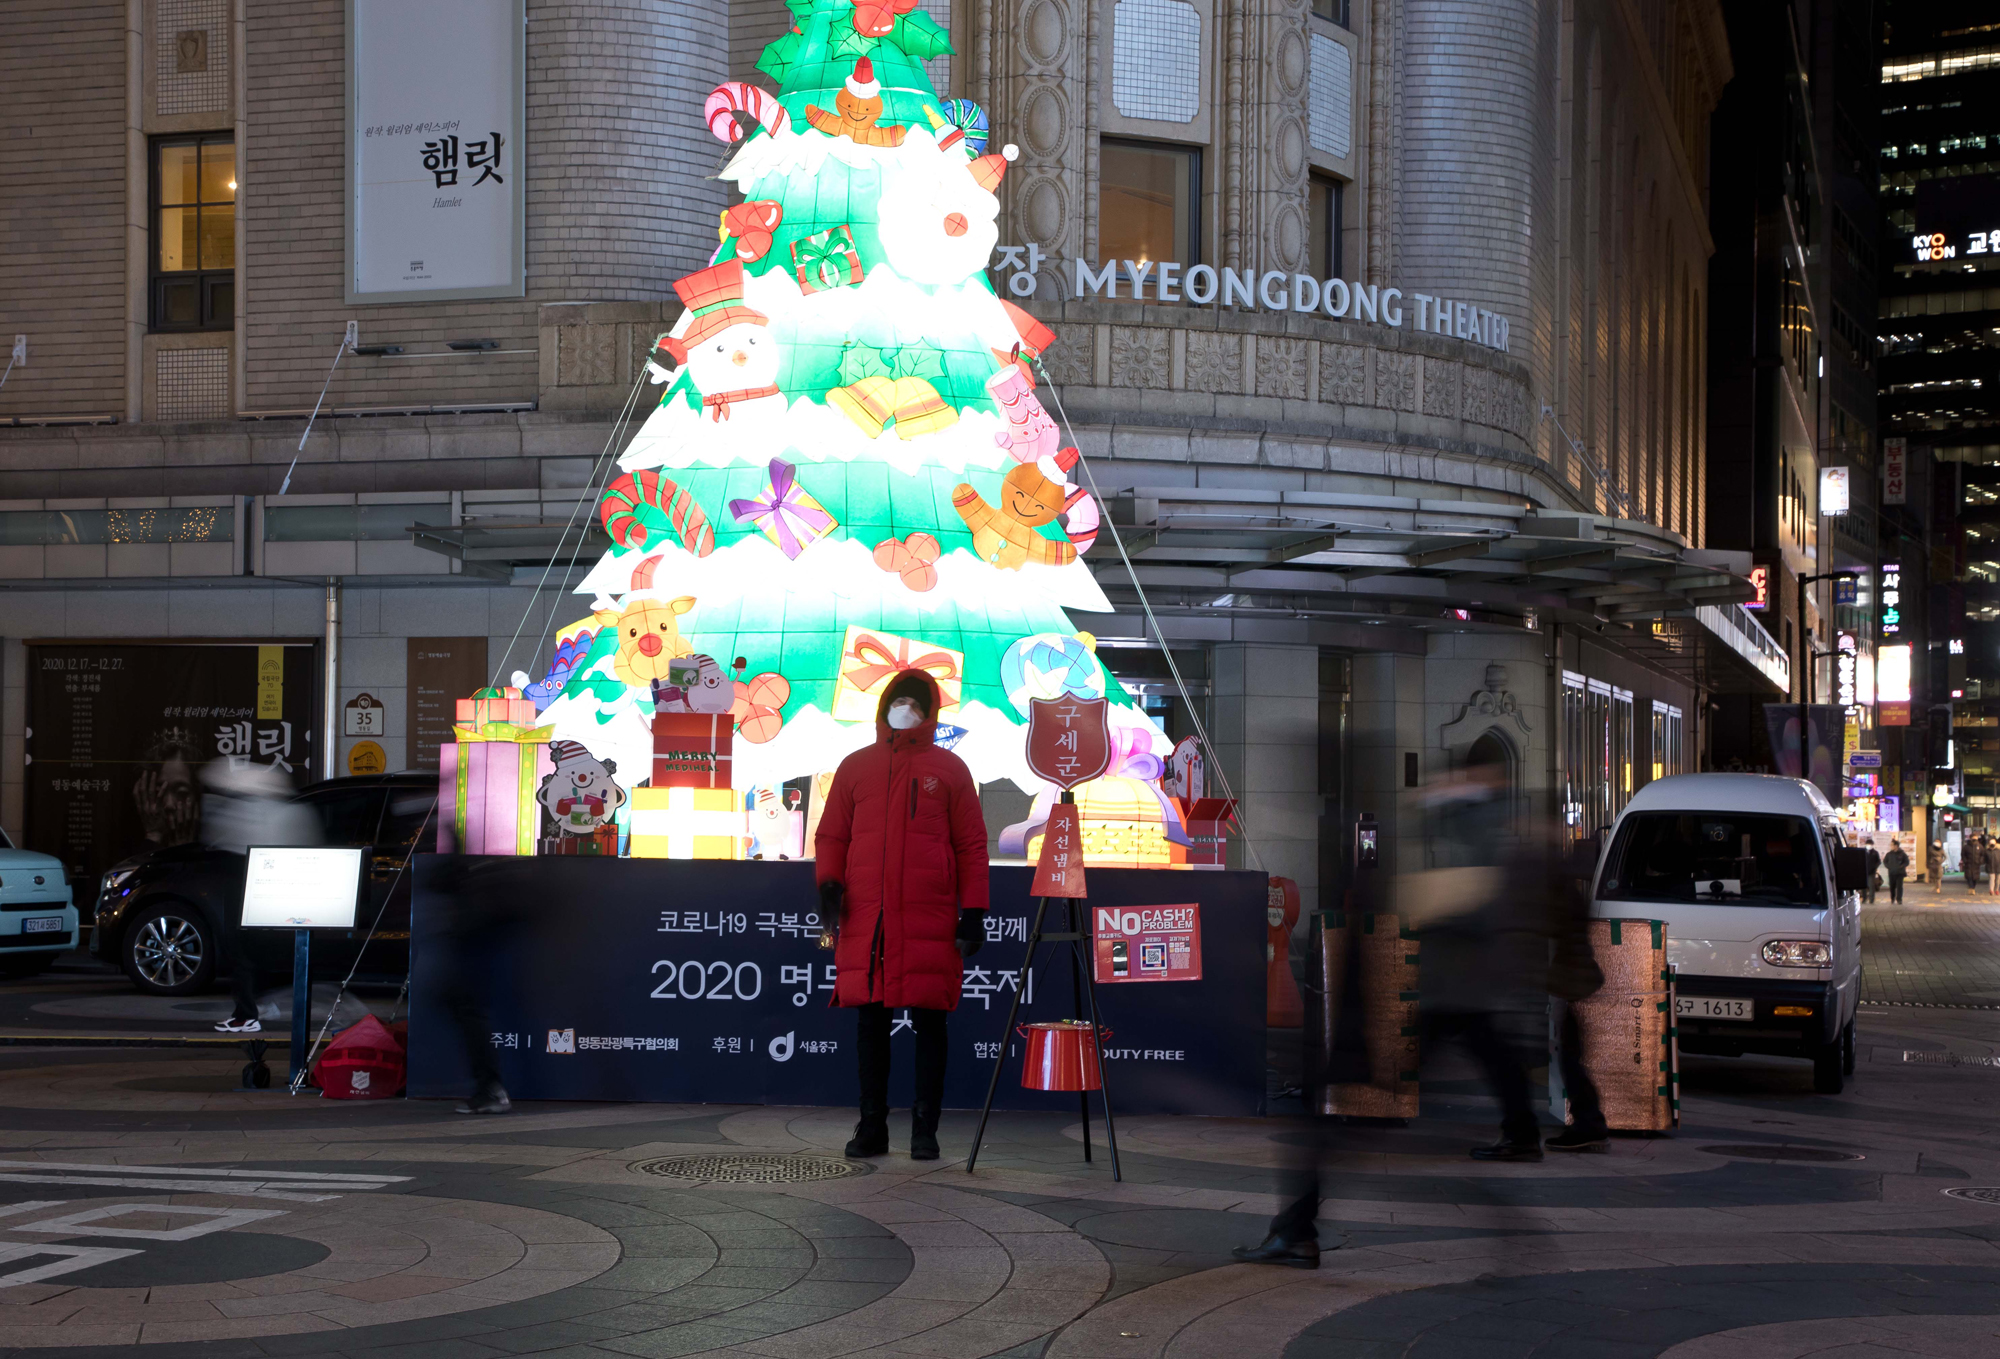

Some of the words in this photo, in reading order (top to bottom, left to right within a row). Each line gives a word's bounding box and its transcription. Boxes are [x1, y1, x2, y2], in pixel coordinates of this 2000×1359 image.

[420, 132, 503, 189] 햄릿
[432, 197, 462, 208] Hamlet
[1913, 233, 1945, 249] KYO
[1917, 246, 1956, 261] WON
[984, 243, 1047, 297] 장
[1075, 257, 1403, 328] MYEONGDONG
[1412, 292, 1510, 353] THEATER
[1887, 445, 1903, 495] 부동산
[42, 657, 66, 670] 2020.
[67, 657, 79, 670] 12.
[356, 712, 373, 725] 35
[935, 726, 954, 738] ISIT
[214, 721, 293, 773] 햄릿
[1054, 705, 1082, 777] 구세군
[668, 750, 718, 762] MERRY
[665, 763, 720, 772] MEDIHEAL
[52, 779, 111, 791] 명동예술극장
[1051, 816, 1072, 887] 자선냄비
[1141, 908, 1195, 923] CASH?
[657, 911, 747, 937] 코로나19
[755, 912, 824, 938] 극복은
[983, 916, 1027, 942] 함께
[1142, 920, 1193, 930] PROBLEM
[650, 960, 762, 1000] 2020
[961, 965, 1033, 1010] 축제
[1676, 999, 1694, 1013] 6구
[1703, 1000, 1744, 1017] 1613
[1631, 998, 1644, 1049] Smart-Q
[489, 1032, 519, 1049] 주최
[578, 1036, 679, 1051] 명동관광특구협의회
[712, 1036, 741, 1054] 후원
[799, 1040, 838, 1054] 서울중구
[974, 1042, 1001, 1059] 협찬
[1144, 1050, 1185, 1061] FREE
